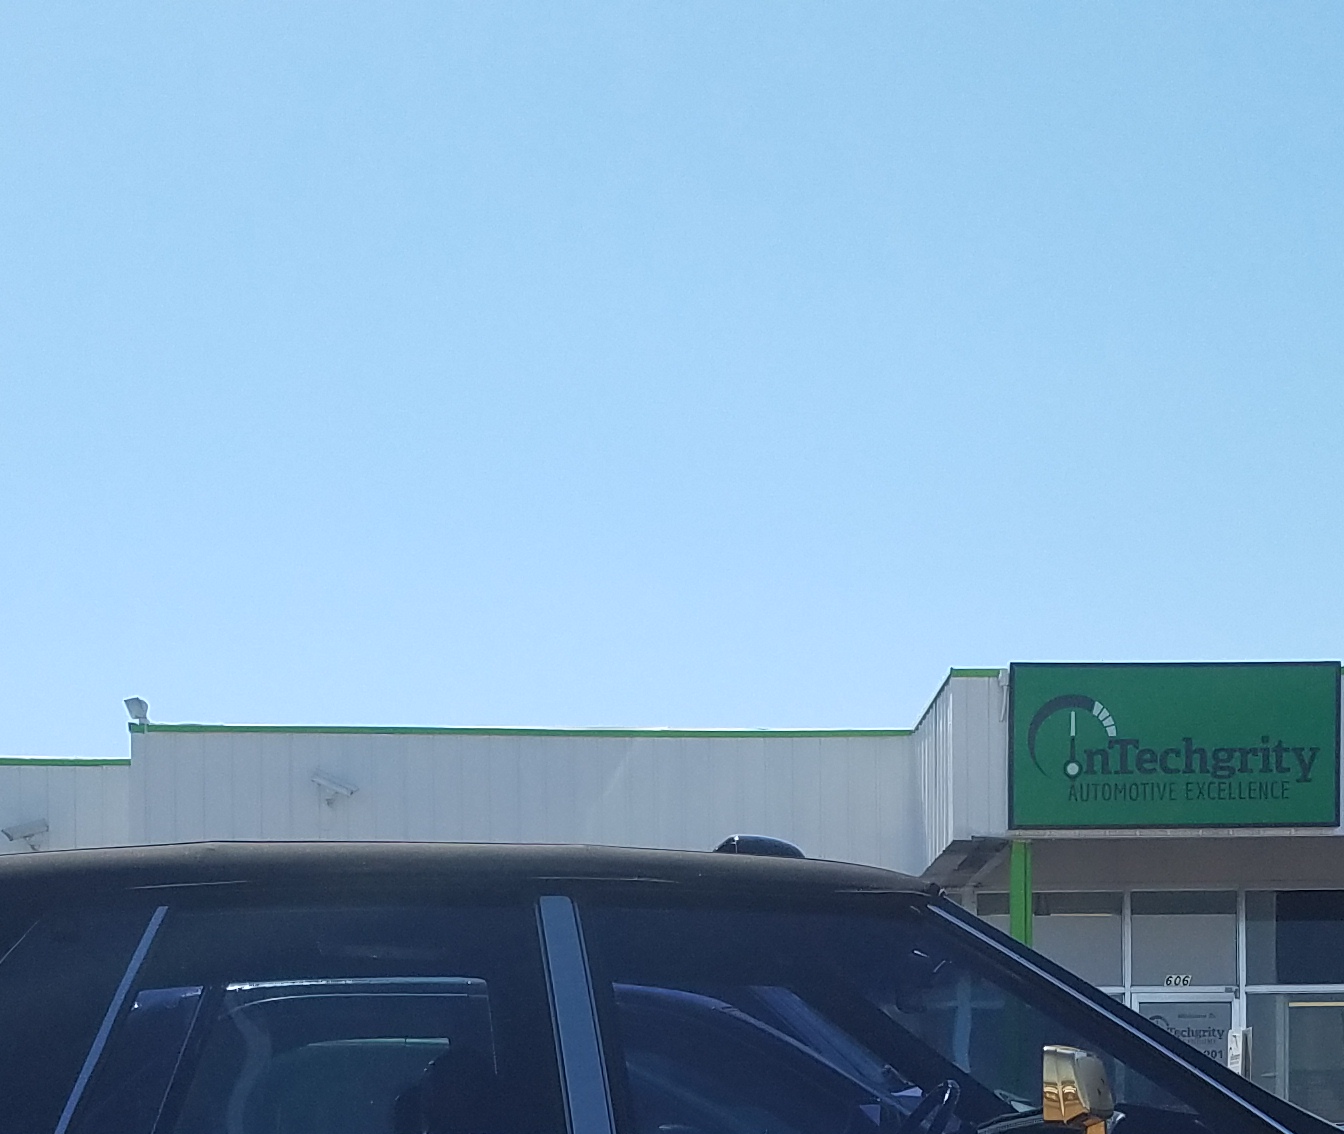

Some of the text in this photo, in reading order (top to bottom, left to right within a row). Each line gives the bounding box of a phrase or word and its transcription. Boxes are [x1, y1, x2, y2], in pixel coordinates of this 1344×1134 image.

[1069, 781, 1291, 802] AUTOMOTIVE EXCELLENCE
[1165, 975, 1191, 986] 606
